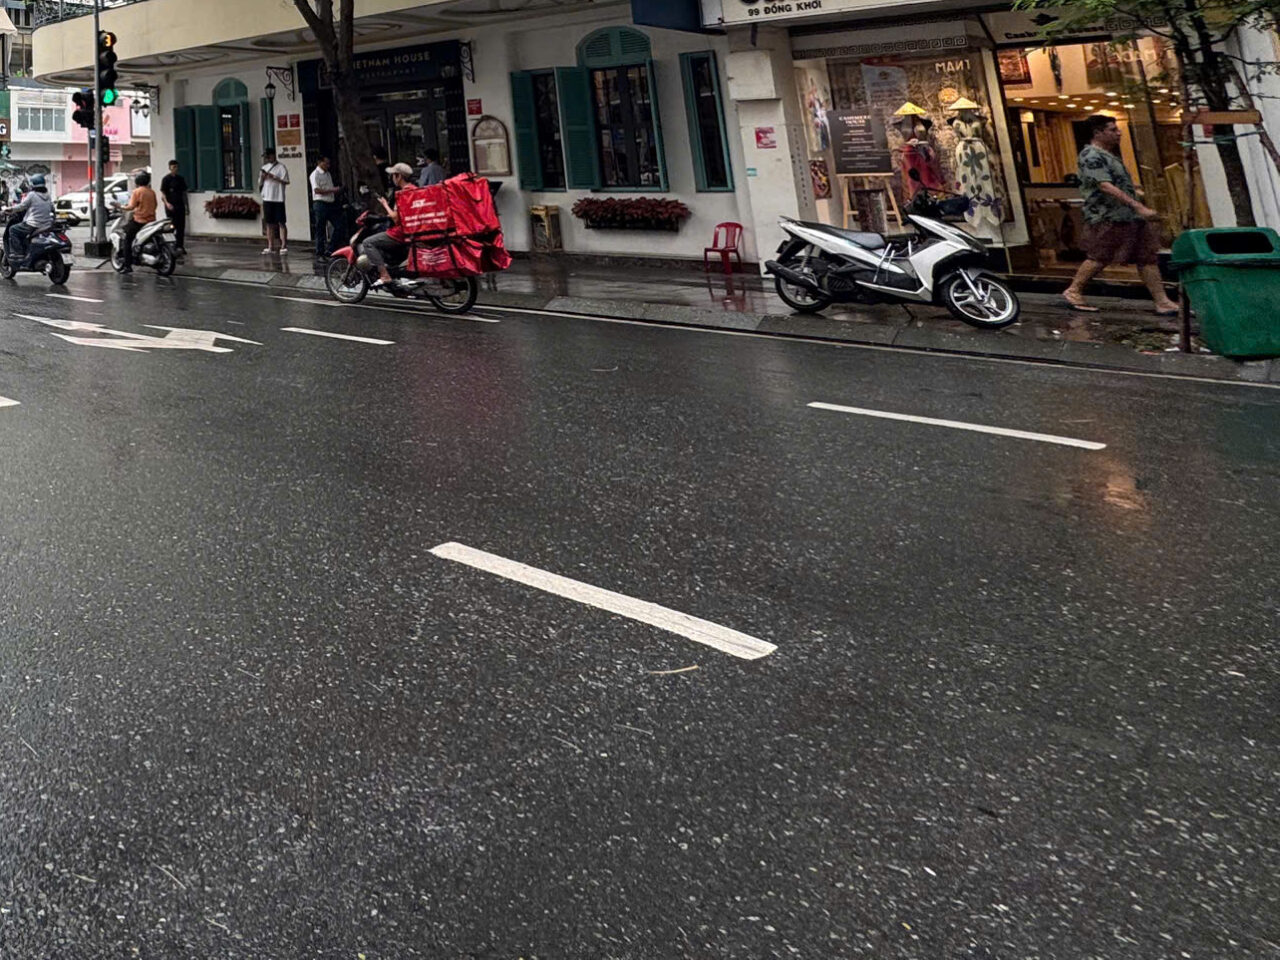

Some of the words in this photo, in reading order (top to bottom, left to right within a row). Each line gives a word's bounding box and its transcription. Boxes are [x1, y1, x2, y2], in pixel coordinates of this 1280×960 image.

[748, 8, 760, 17] 99
[105, 34, 111, 47] 3
[352, 58, 390, 70] IETNAM
[394, 51, 431, 64] HOUSE
